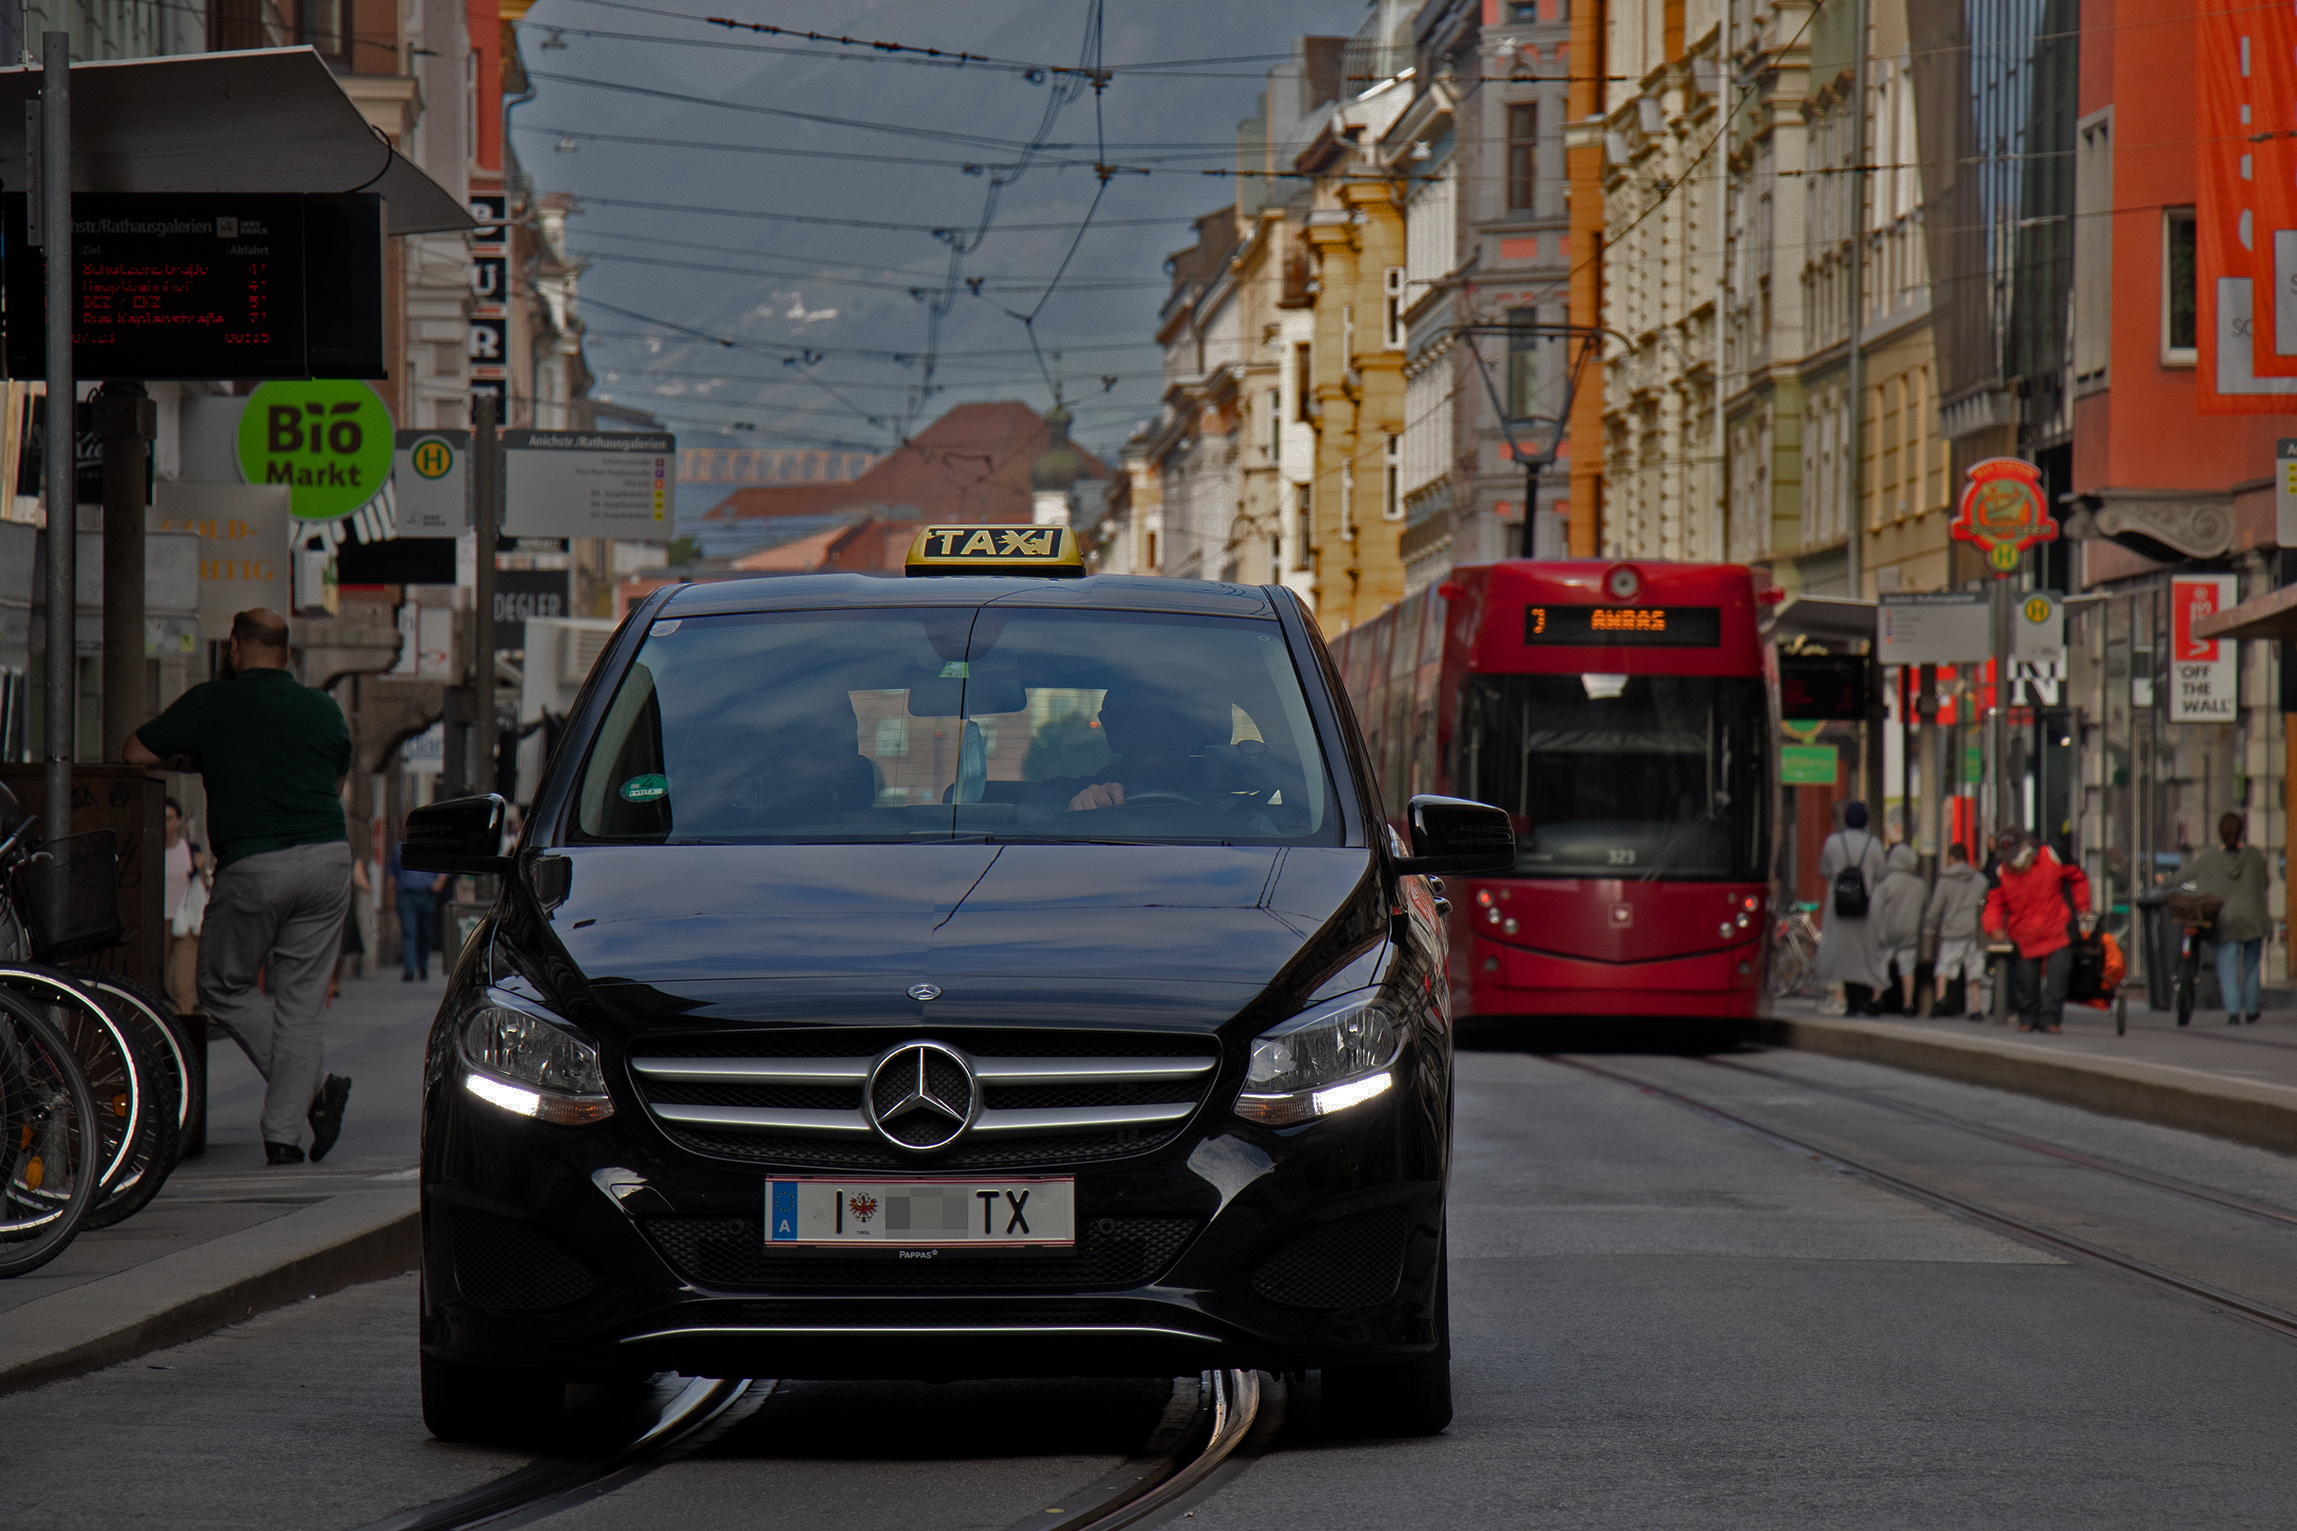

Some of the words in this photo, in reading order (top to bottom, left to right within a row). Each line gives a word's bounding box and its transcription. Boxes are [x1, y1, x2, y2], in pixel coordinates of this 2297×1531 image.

[71, 217, 213, 238] hstr./Rathausgalerien
[83, 244, 102, 256] Ziel
[230, 244, 269, 256] Abfahrt
[422, 447, 442, 472] H
[266, 461, 362, 489] Markt
[936, 530, 1055, 556] TAXI
[200, 560, 276, 582] HTIG
[2182, 683, 2212, 696] THE
[1607, 849, 1636, 865] 323
[835, 1189, 845, 1235] I
[975, 1188, 1031, 1235] TX
[779, 1219, 791, 1233] A
[899, 1250, 932, 1259] PAPPAS
